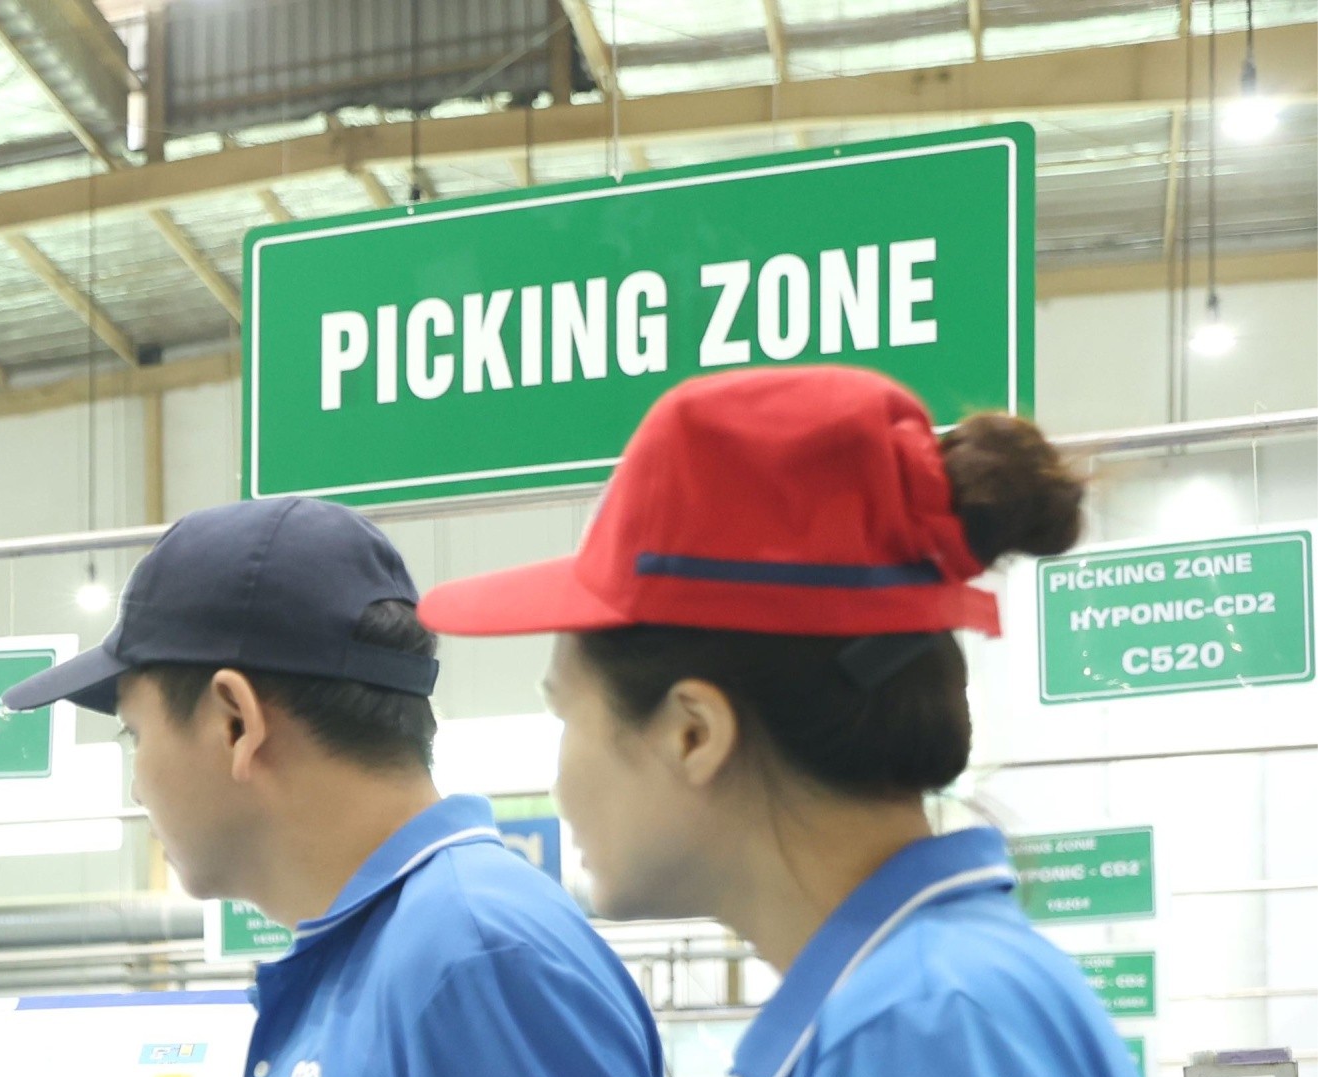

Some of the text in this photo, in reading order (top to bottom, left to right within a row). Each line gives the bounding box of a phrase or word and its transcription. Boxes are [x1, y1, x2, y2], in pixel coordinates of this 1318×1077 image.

[321, 238, 937, 410] PICKING ZONE
[1049, 552, 1253, 593] PICKING ZONE
[1069, 592, 1276, 632] HYPONIC-CD2
[1121, 640, 1225, 676] C520
